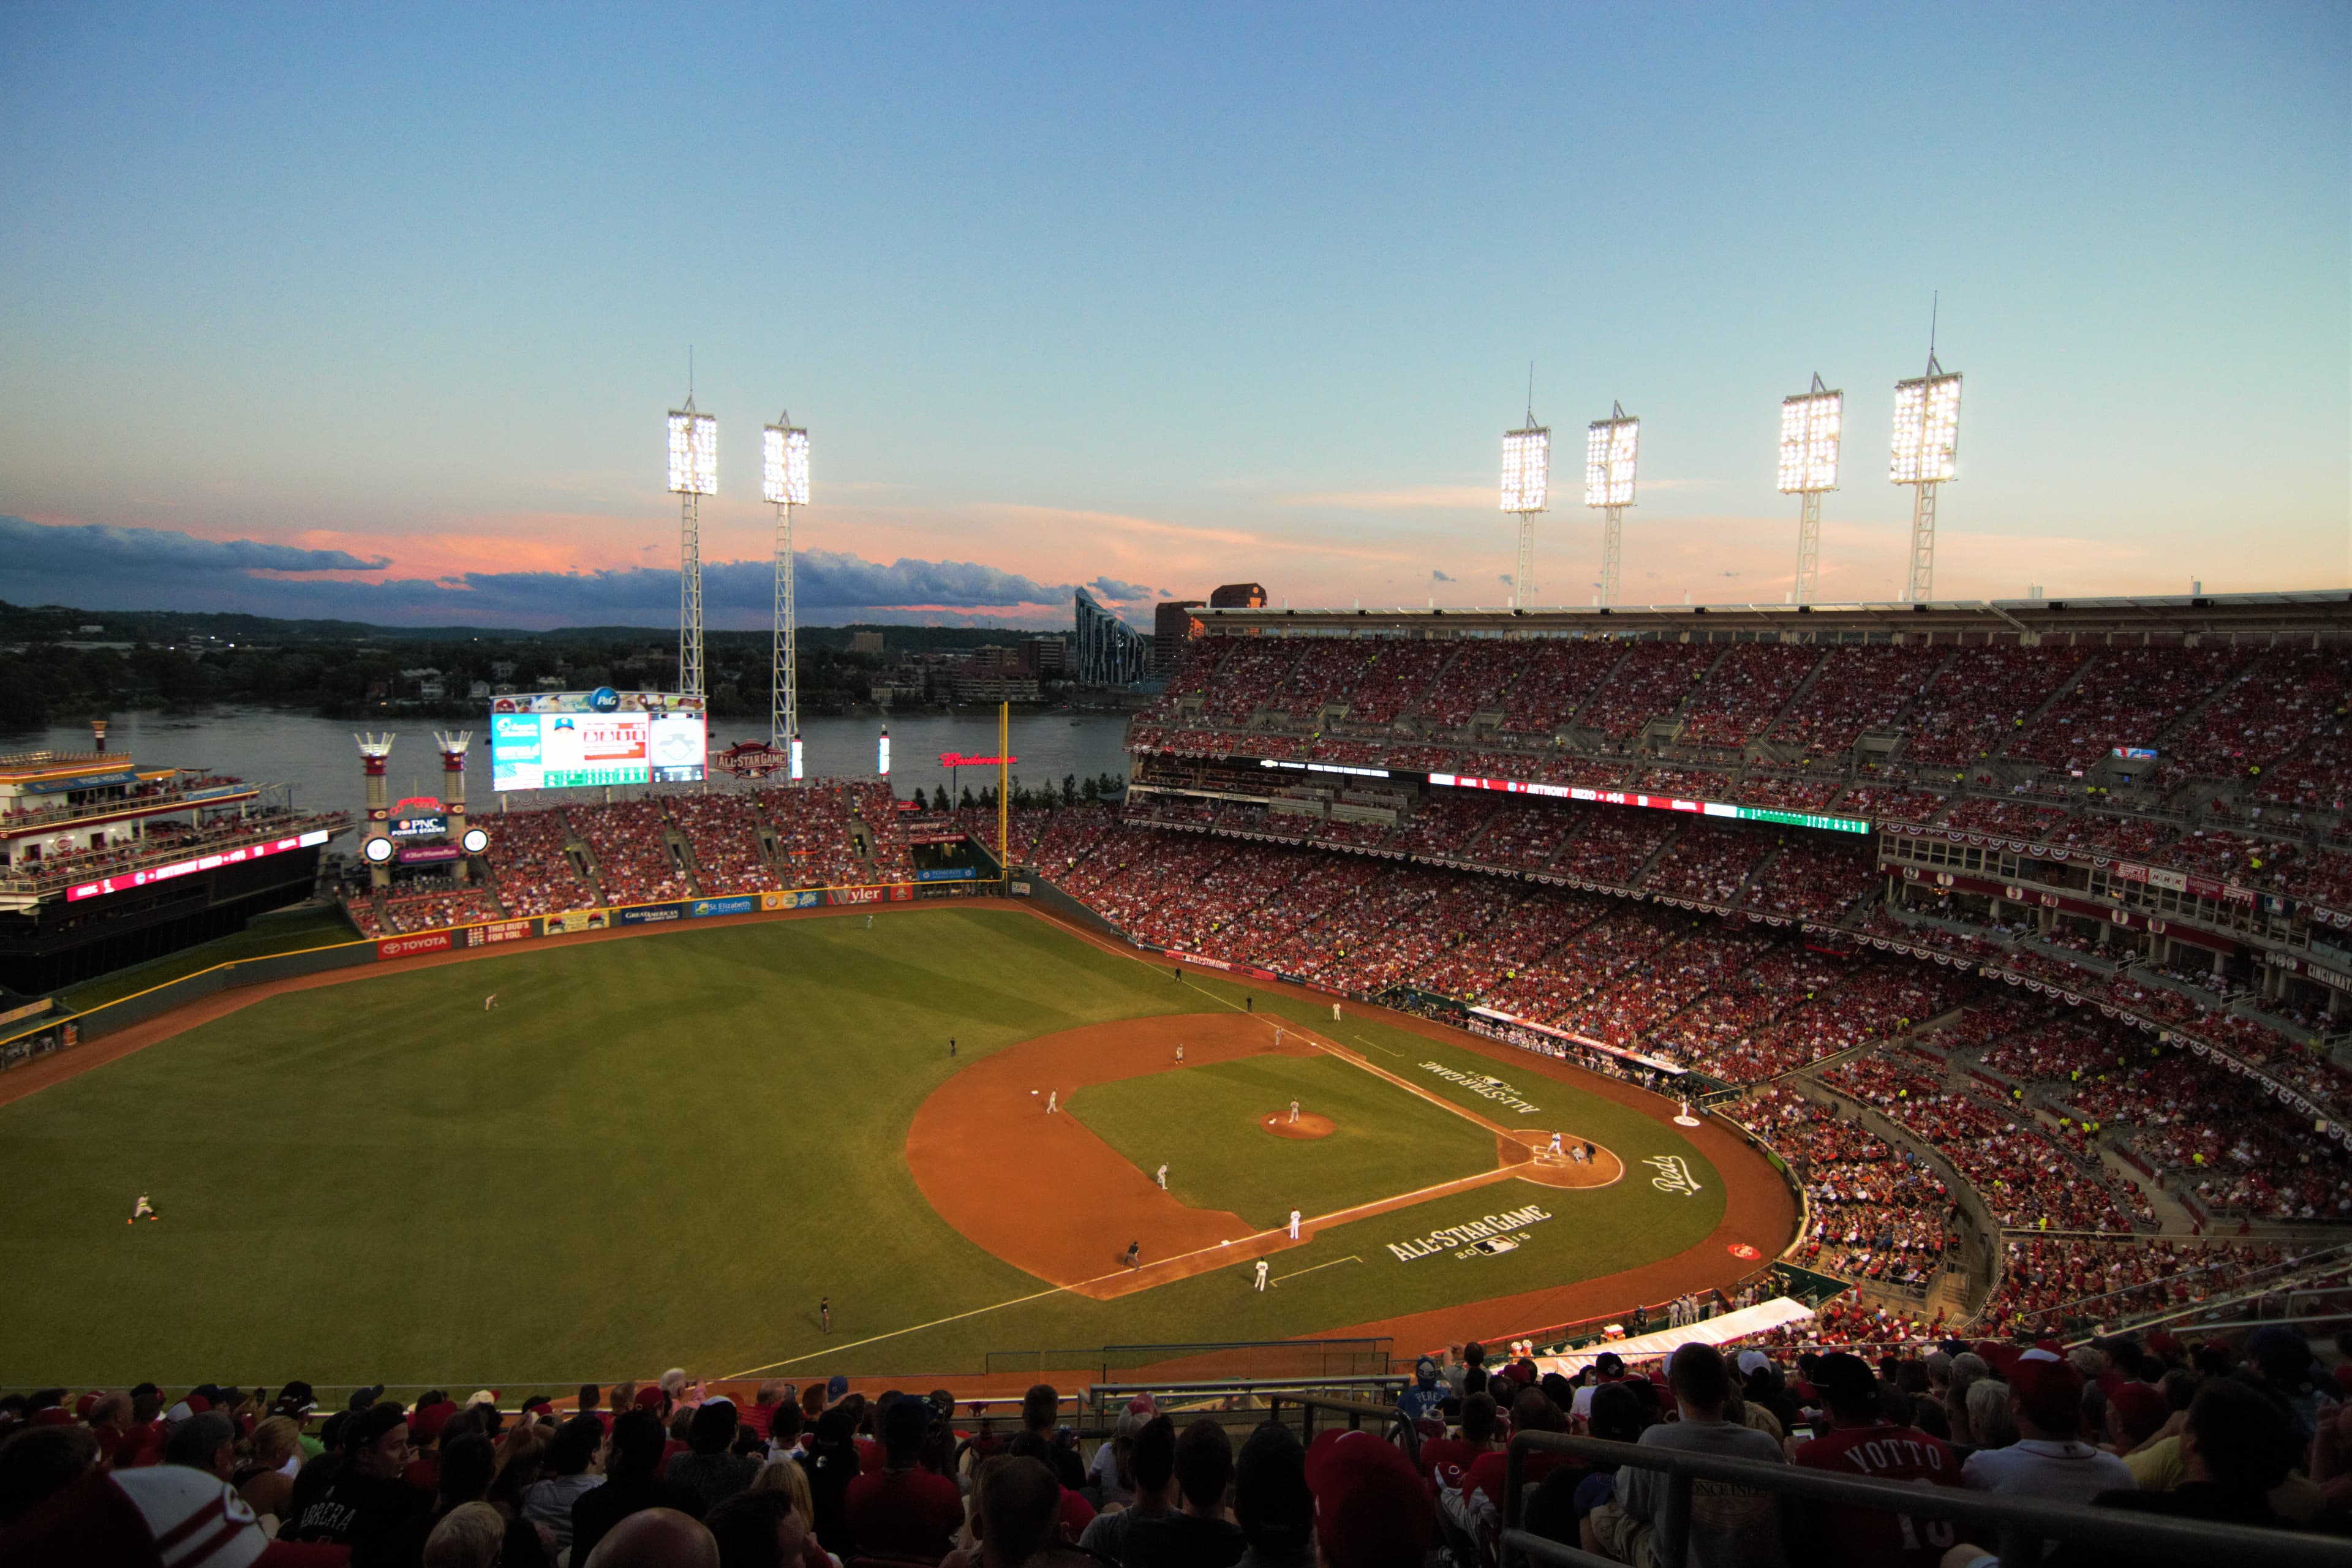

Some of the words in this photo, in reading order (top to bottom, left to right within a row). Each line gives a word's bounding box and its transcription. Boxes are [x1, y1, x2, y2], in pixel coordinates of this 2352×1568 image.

[597, 696, 617, 706] P&G
[761, 752, 785, 764] GAME
[1526, 783, 1569, 798] ANTHONY
[1570, 788, 1596, 801] RIZZO
[411, 818, 439, 829] PNC
[1904, 867, 1917, 878] 42
[2118, 862, 2147, 875] ESPN
[2115, 871, 2147, 882] DEPORTES
[2214, 883, 2226, 892] GAME
[2229, 886, 2260, 902] ESPN
[829, 888, 880, 905] Wyler
[2043, 895, 2055, 906] 20
[2230, 896, 2251, 907] RADIO
[718, 900, 750, 910] Elizabeth
[488, 925, 505, 933] THIS
[506, 920, 530, 930] BUD'S
[402, 936, 447, 950] TOYOTA
[488, 932, 503, 941] FOR
[1216, 960, 1231, 971] GAME
[2307, 963, 2352, 992] CINCINNAT
[1417, 1061, 1466, 1082] GAME
[1642, 1155, 1702, 1196] Reds
[1483, 1204, 1553, 1231] GAME
[1558, 1340, 1659, 1375] AMCAN
[1414, 1390, 1445, 1403] PEREZ
[1844, 1439, 1941, 1474] VOTTO
